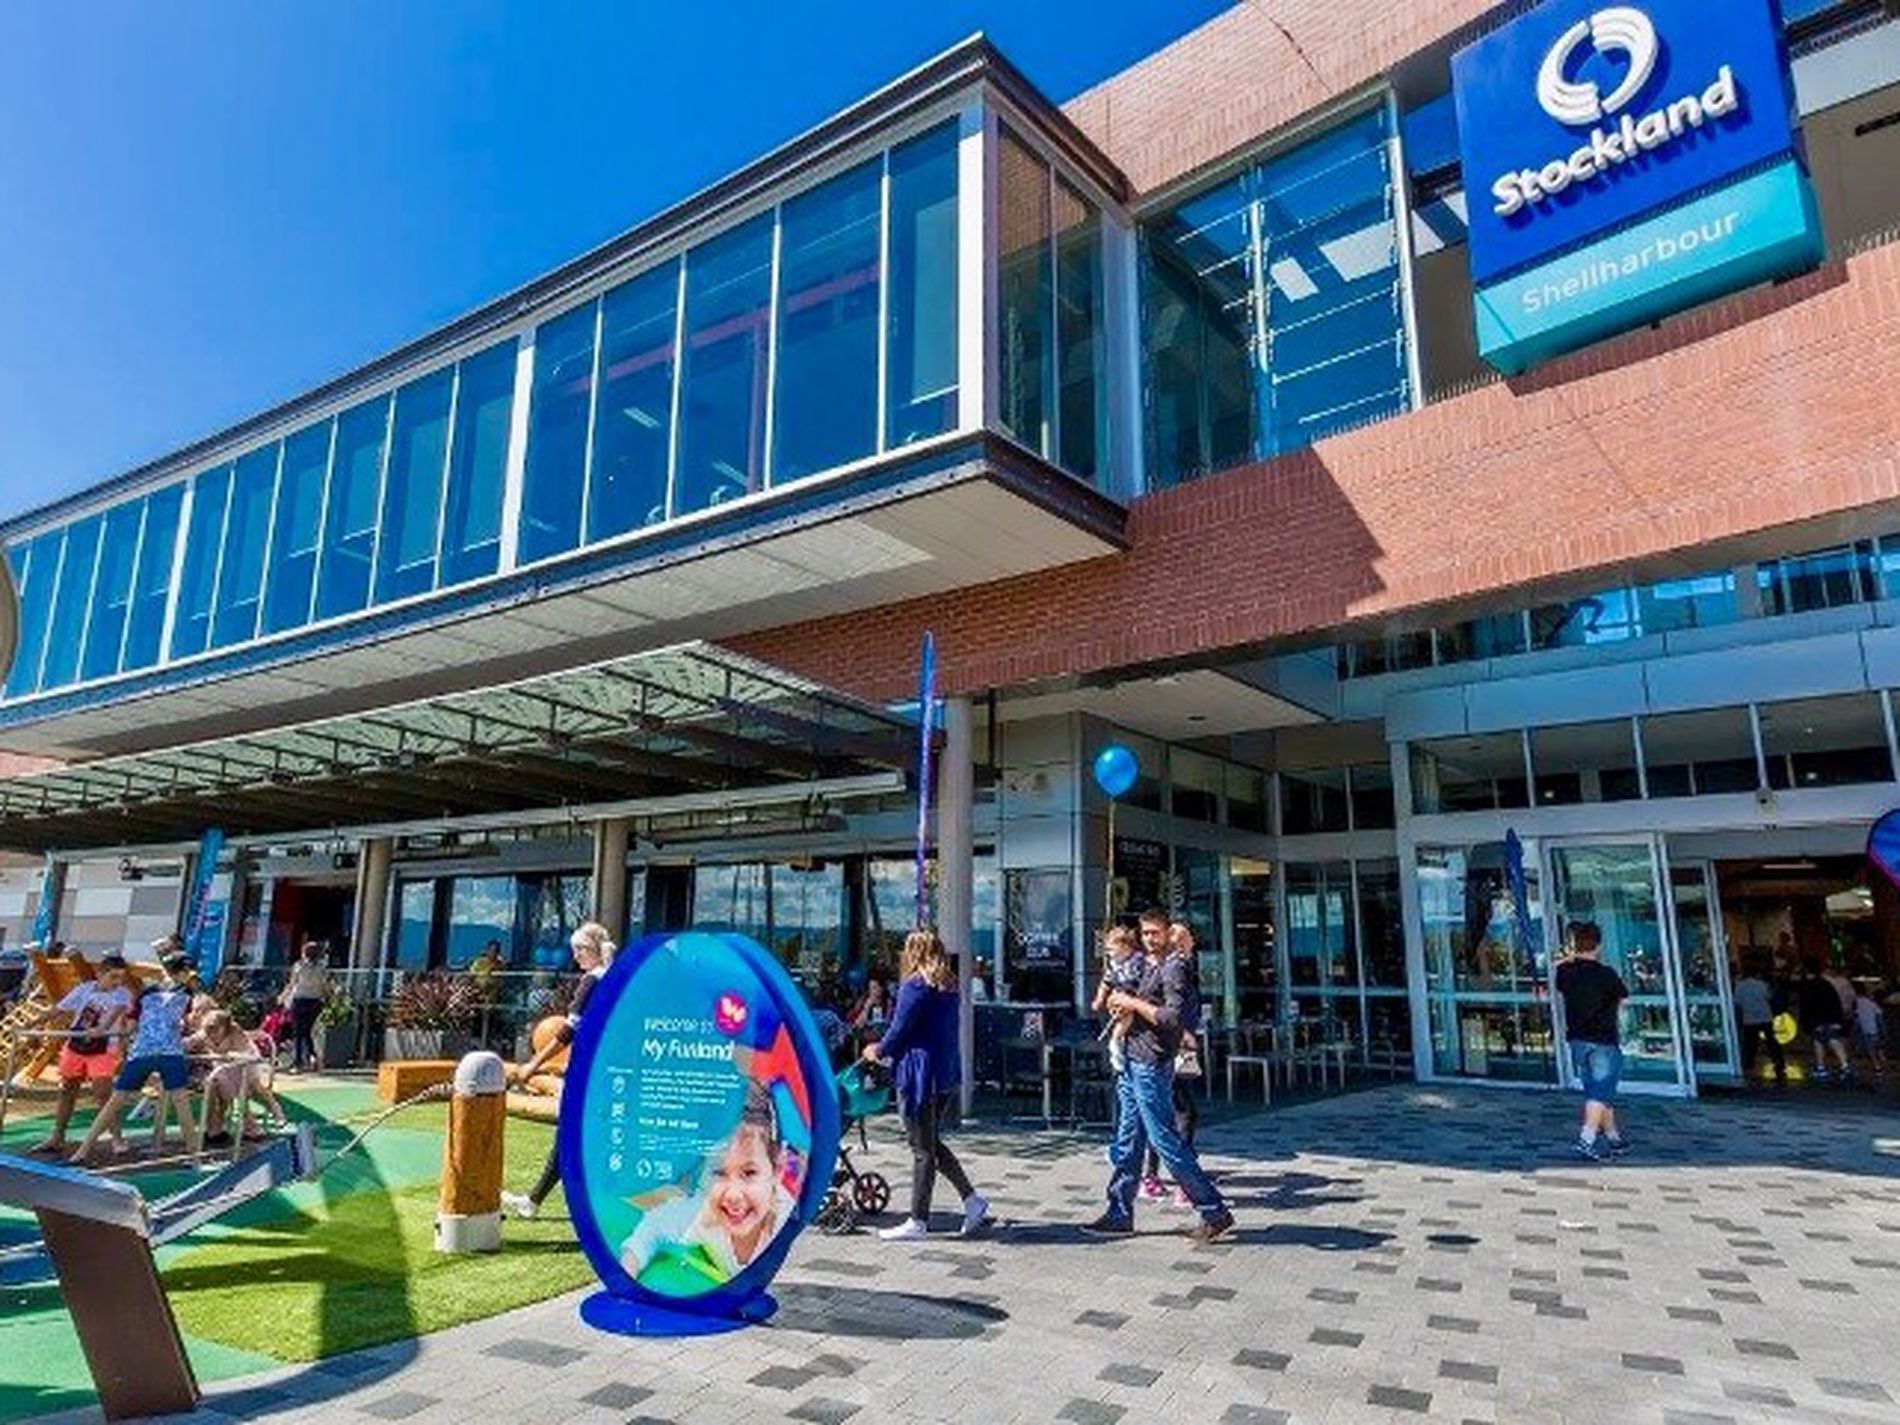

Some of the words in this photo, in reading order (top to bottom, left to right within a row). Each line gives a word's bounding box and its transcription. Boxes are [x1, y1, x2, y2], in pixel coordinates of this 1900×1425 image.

[1491, 64, 1738, 215] Stockland
[1523, 211, 1740, 312] Shellharbour
[641, 1038, 667, 1062] My
